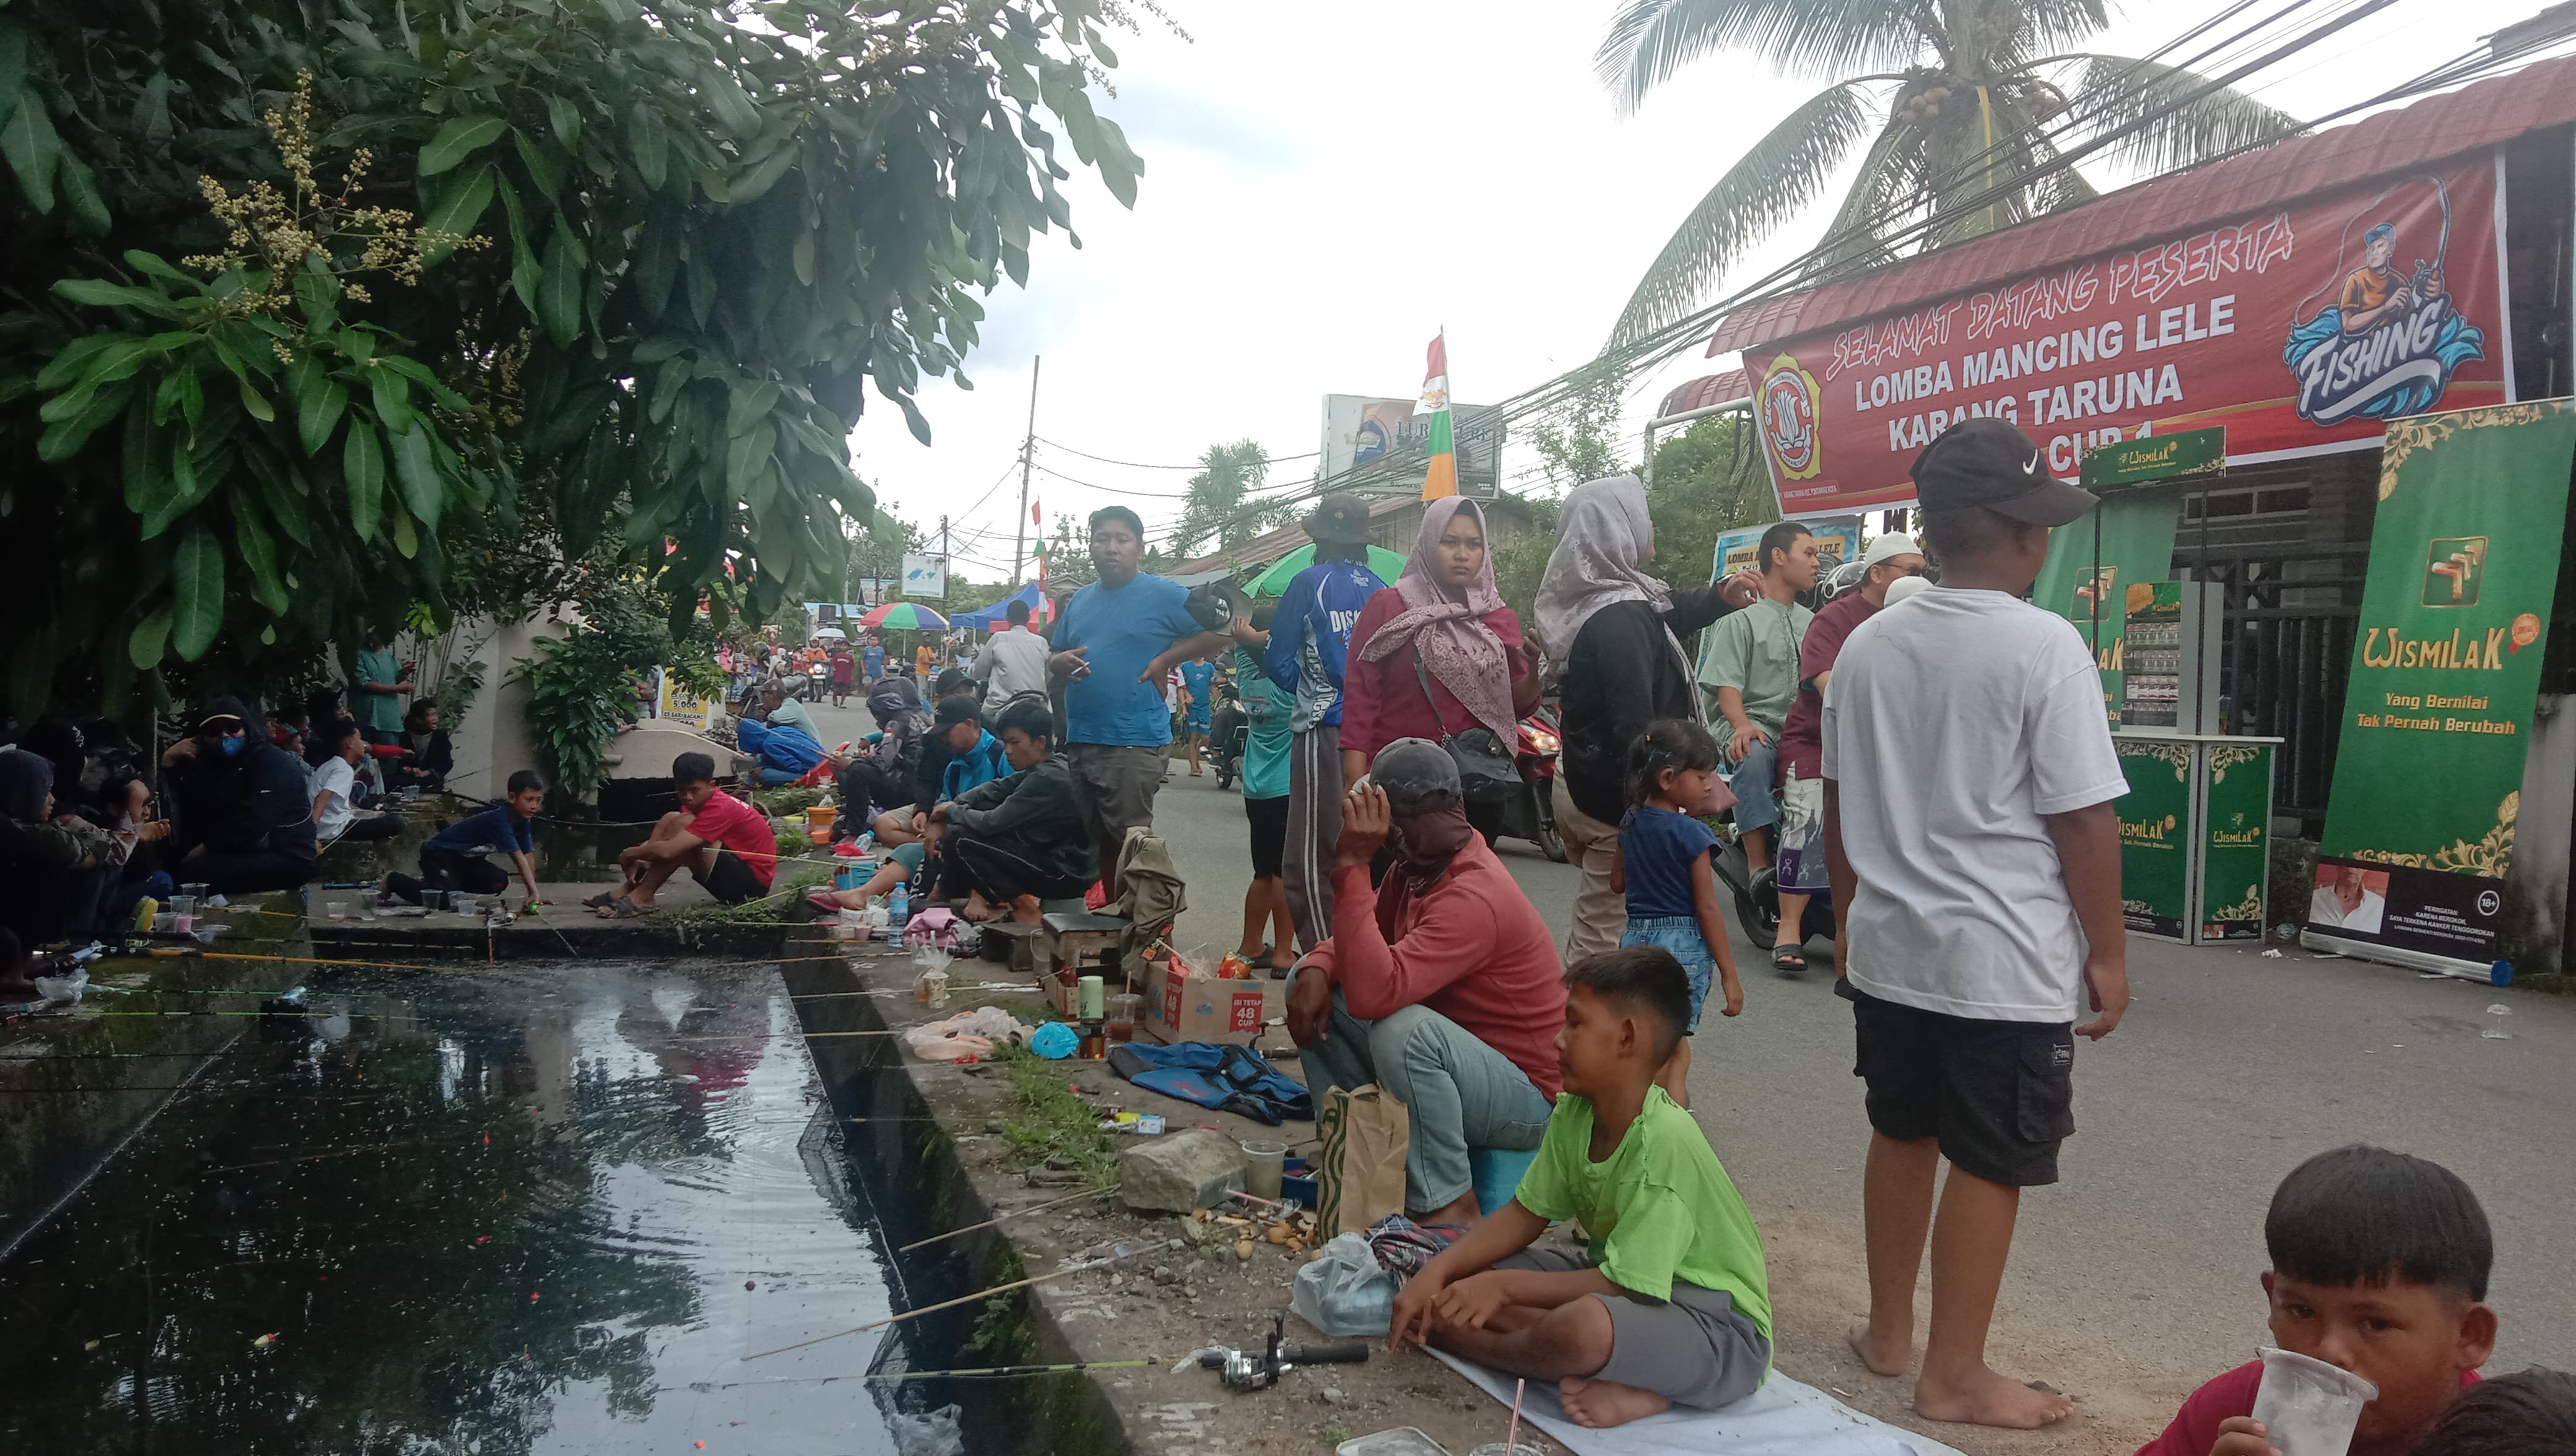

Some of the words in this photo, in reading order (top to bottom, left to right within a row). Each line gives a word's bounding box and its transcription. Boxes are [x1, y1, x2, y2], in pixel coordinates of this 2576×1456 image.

[1826, 298, 1964, 381] SELAMAT
[1967, 262, 2099, 340] DATANG
[2109, 212, 2294, 305] PESERTA
[1855, 360, 1954, 412] LOMBA
[1962, 320, 2124, 389] MANCING
[2136, 294, 2235, 352] LELE
[2299, 298, 2445, 413] FISHING
[2027, 363, 2183, 426] TARUNA
[1728, 552, 1754, 564] LOMBA
[673, 700, 697, 709] 5.000
[2386, 693, 2421, 710] Yang
[2426, 693, 2489, 710] Bernilai
[2357, 714, 2380, 728] Tak
[2385, 714, 2440, 731] Pernah
[2445, 718, 2516, 735] Berubah
[2481, 898, 2496, 908] 18+
[2416, 912, 2438, 921] KARENA
[2403, 917, 2427, 927] TERKENA
[2427, 920, 2451, 930] KANKER
[2451, 923, 2495, 937] TENGGOROKAN
[1237, 1007, 1255, 1019] 48
